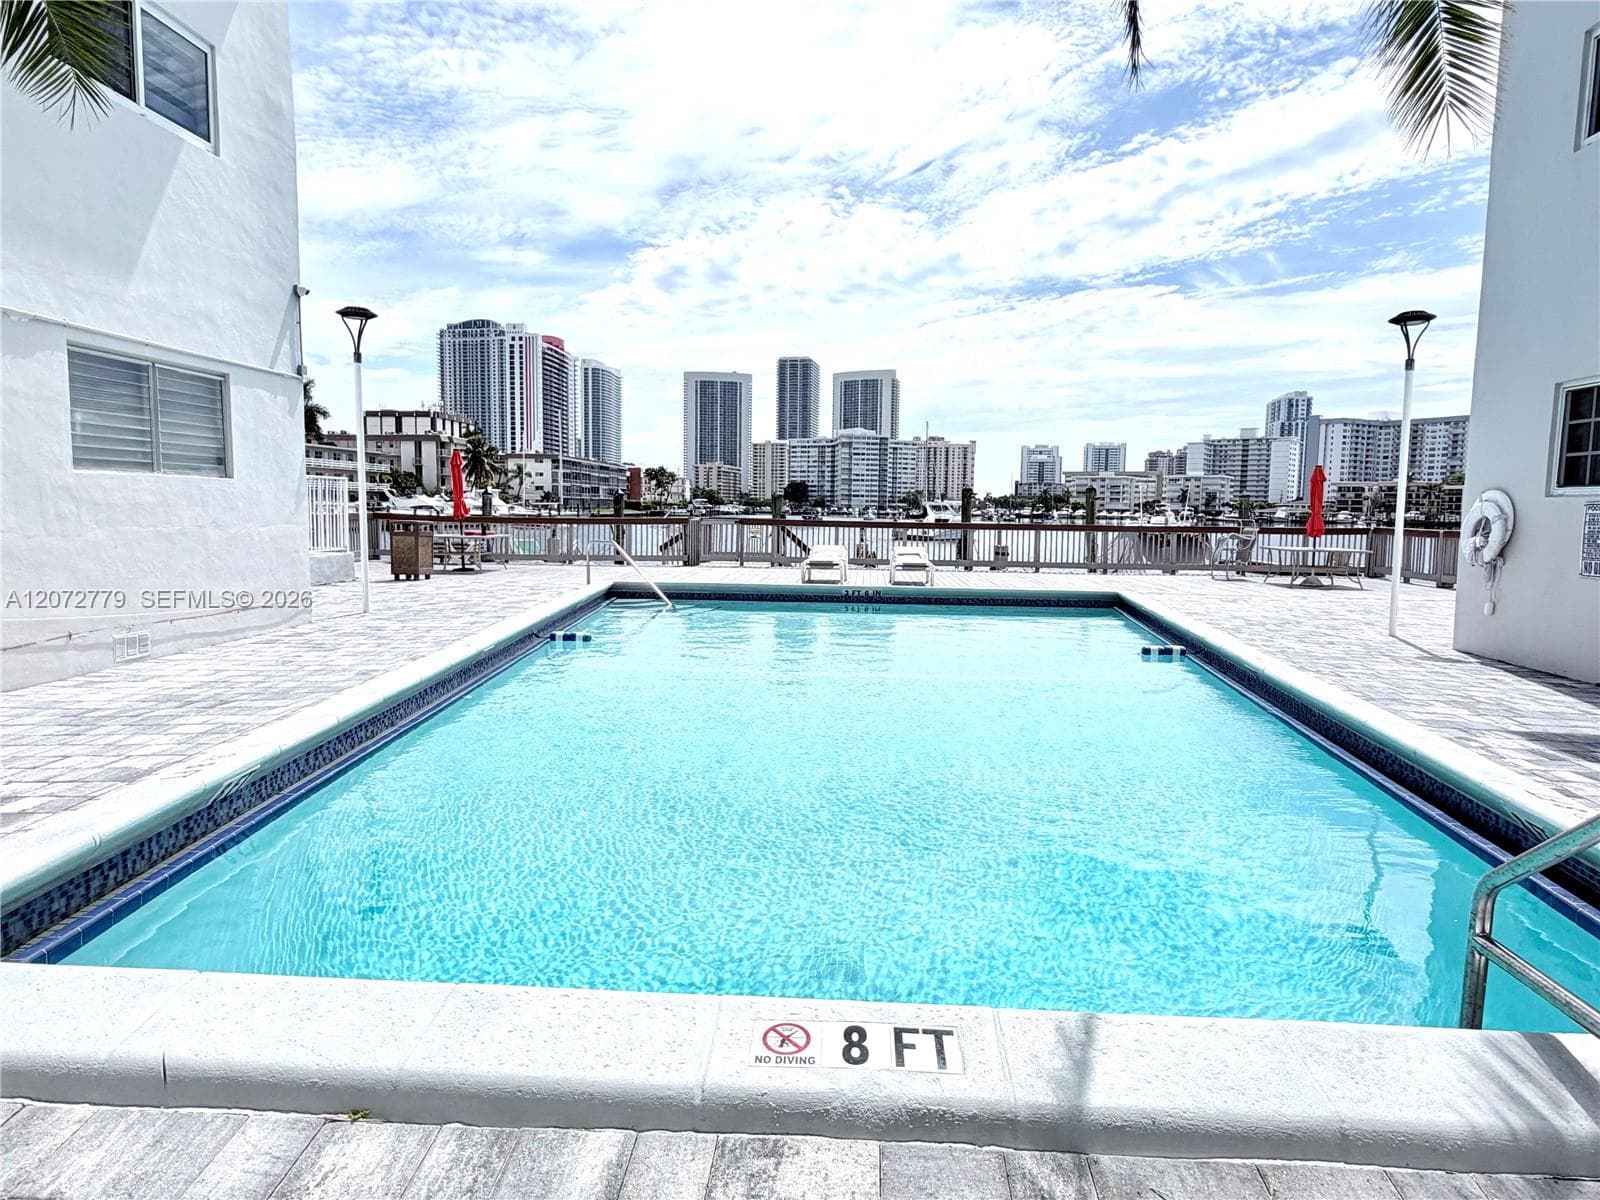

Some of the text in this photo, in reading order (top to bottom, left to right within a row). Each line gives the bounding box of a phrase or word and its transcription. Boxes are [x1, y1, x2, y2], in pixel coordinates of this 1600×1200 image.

[754, 1055, 816, 1065] NO DIVING
[842, 1025, 954, 1070] 8 FT
